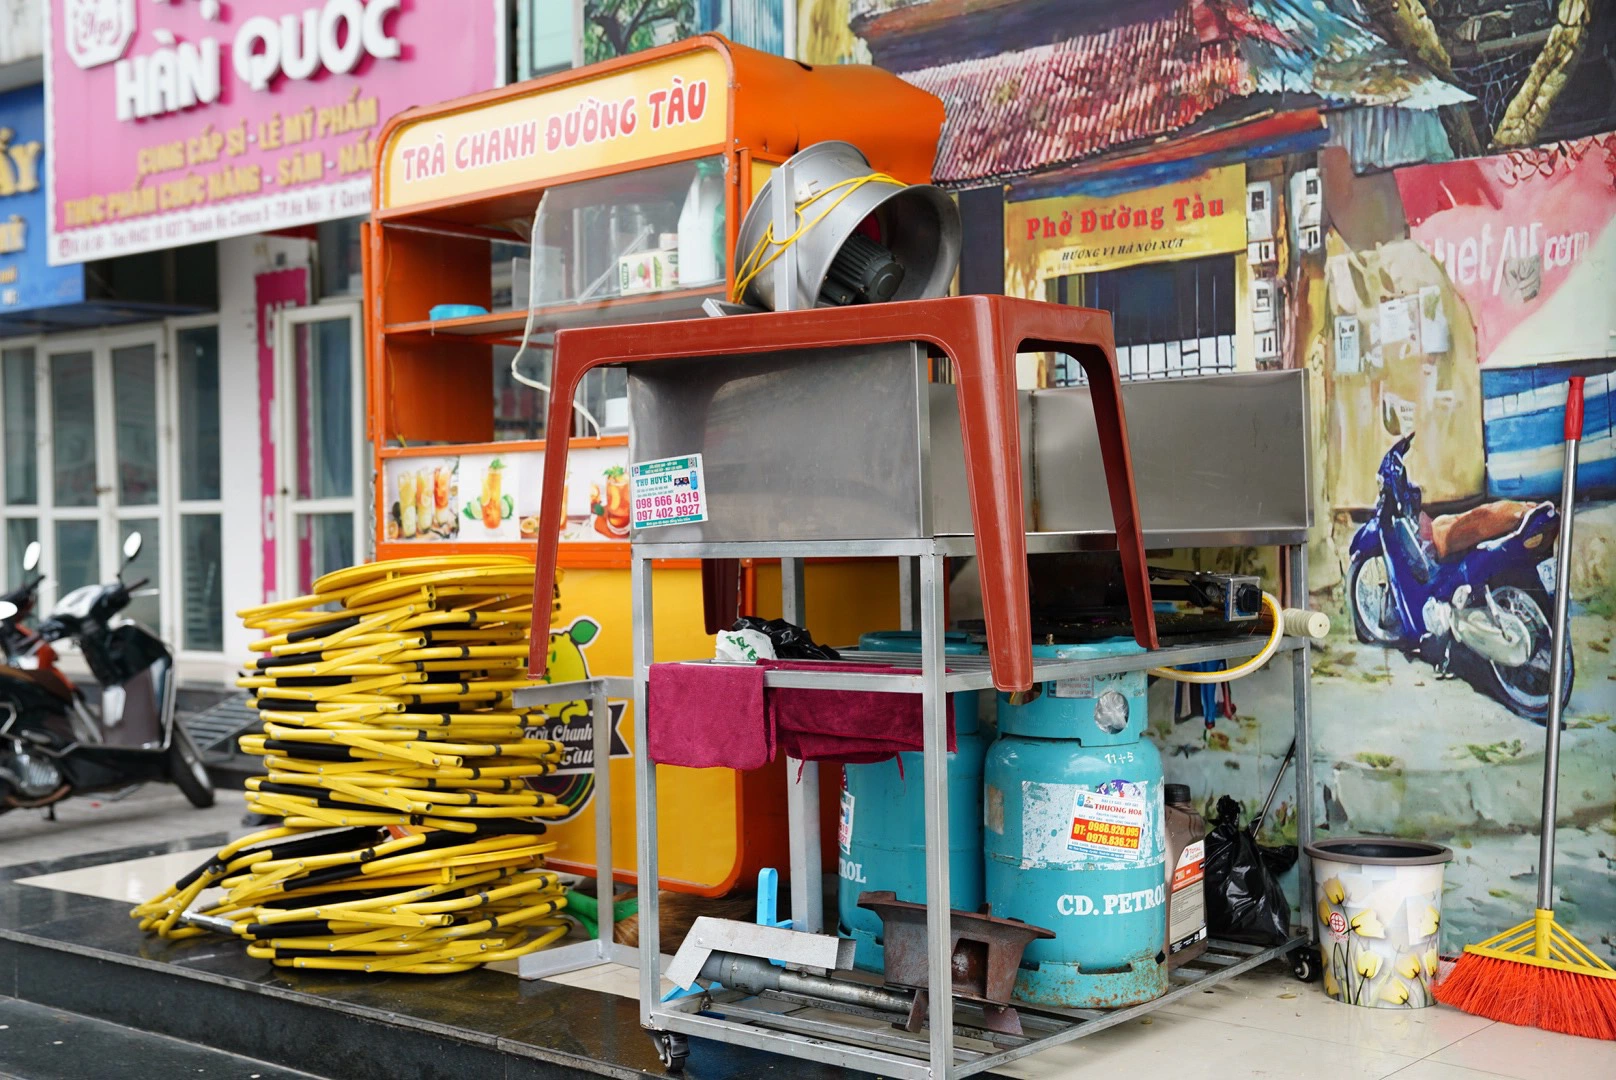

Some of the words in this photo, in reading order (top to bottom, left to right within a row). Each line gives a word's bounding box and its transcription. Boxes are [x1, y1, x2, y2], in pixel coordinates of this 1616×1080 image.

[115, 29, 221, 121] HÀN
[403, 135, 446, 181] TRÀ
[454, 122, 537, 171] CHANH
[545, 99, 637, 151] ĐƯỜNG
[649, 78, 708, 129] TÀU
[1026, 211, 1072, 241] Phở
[1080, 203, 1164, 235] Đường
[1173, 194, 1225, 222] Tàu
[636, 498, 652, 509] 098
[655, 495, 672, 507] 666
[675, 492, 699, 503] 4319
[637, 510, 652, 521] 097
[656, 507, 673, 518] 402
[676, 504, 700, 516] 9927
[552, 723, 593, 742] Chanh
[1056, 894, 1100, 916] CD.
